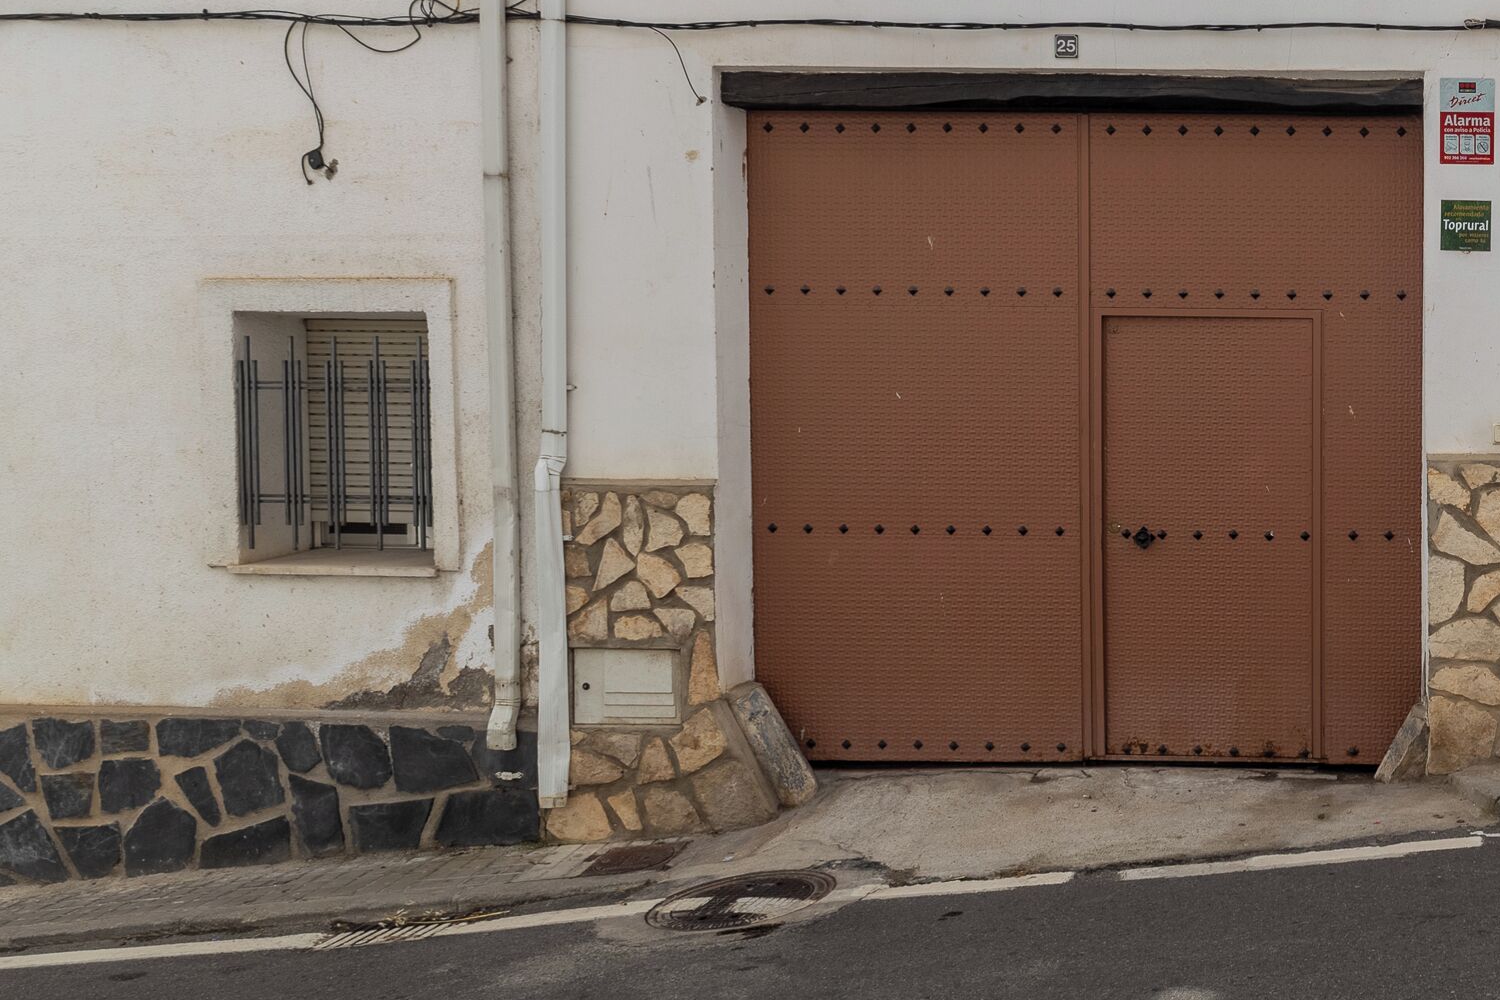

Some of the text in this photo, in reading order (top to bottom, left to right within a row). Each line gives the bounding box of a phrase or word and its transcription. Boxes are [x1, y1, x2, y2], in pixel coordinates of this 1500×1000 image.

[1057, 40, 1076, 52] 25
[1444, 114, 1491, 127] Alarma
[1443, 219, 1489, 233] Toprural
